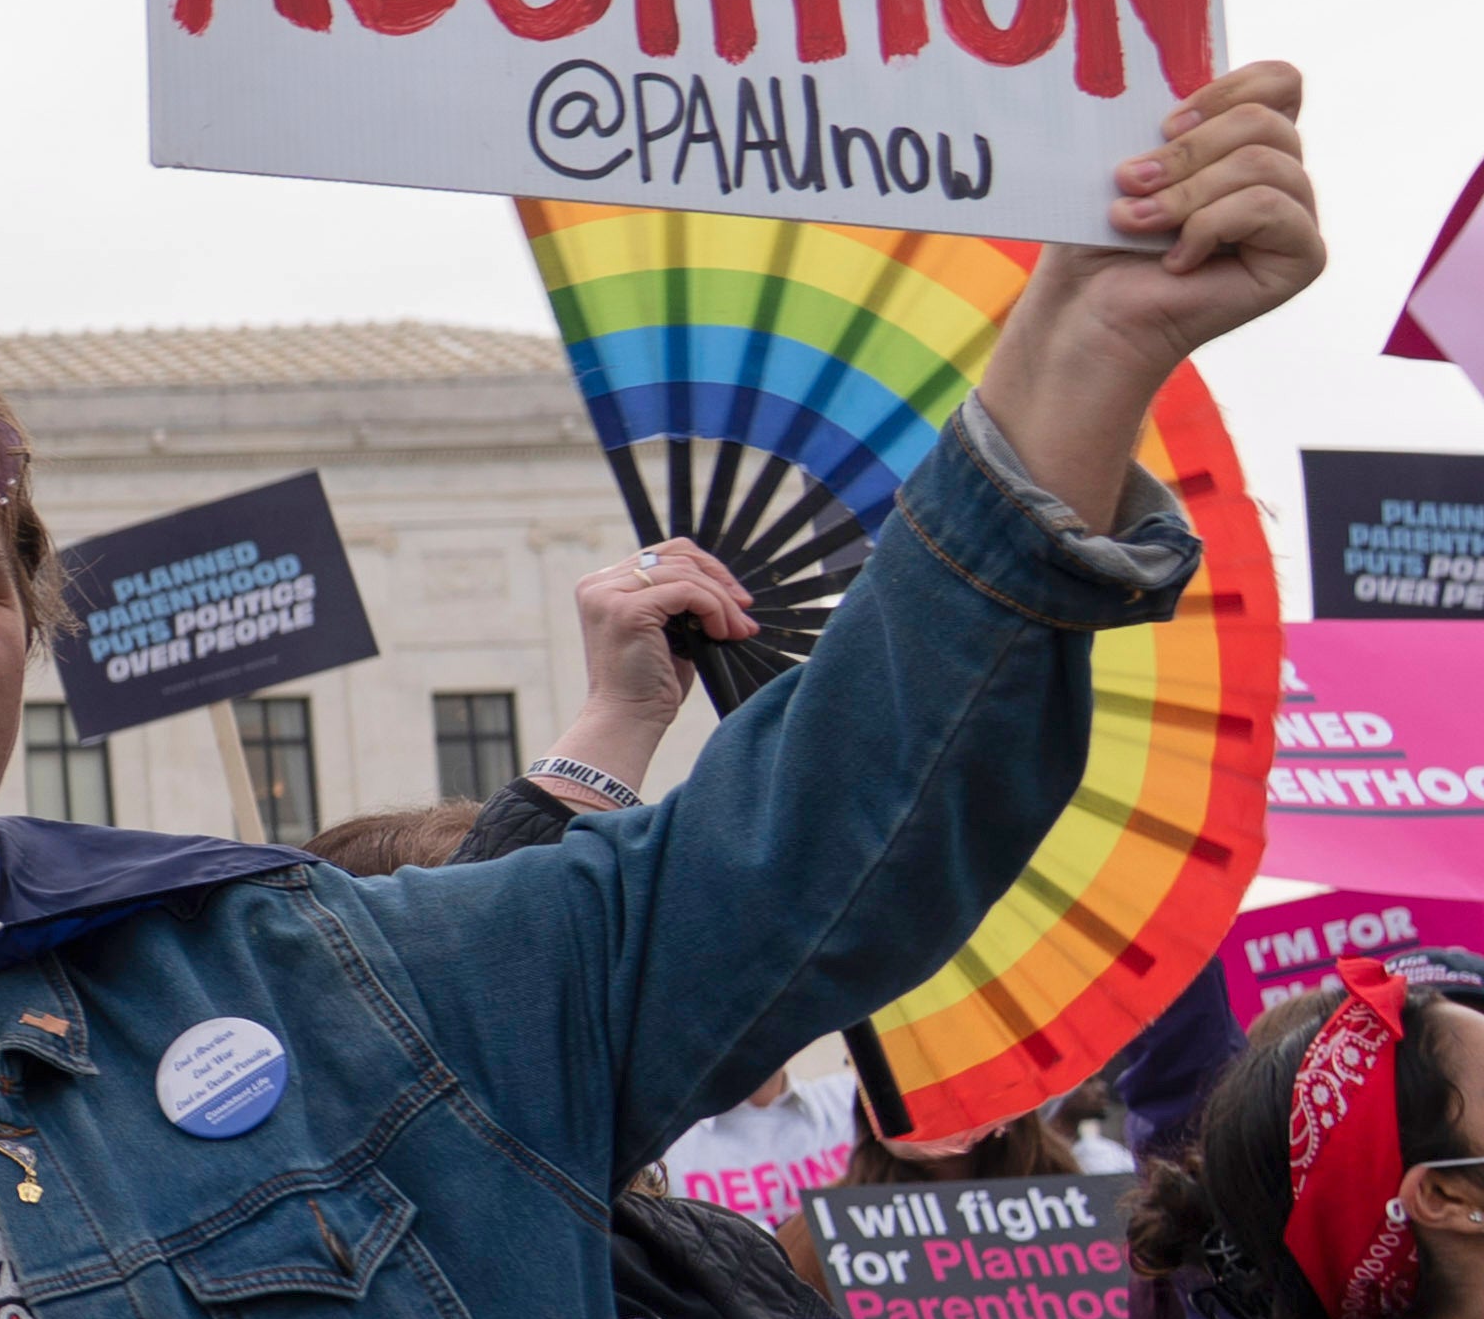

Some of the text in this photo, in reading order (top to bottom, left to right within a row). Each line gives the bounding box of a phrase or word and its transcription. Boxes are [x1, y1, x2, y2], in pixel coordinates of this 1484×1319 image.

[87, 553, 301, 636] PARENTHOOD
[112, 540, 259, 603] PLANNED
[1354, 574, 1438, 606] OVER
[88, 574, 316, 664] PUTS POLITICS
[107, 638, 190, 683] OVER
[195, 601, 314, 658] PEOPLE
[548, 758, 604, 785] FAMILY
[1244, 906, 1418, 973] I'M FOR
[811, 1196, 837, 1241] I
[848, 1192, 948, 1239] will
[956, 1185, 1096, 1243] fight
[828, 1239, 1130, 1287] for Planne
